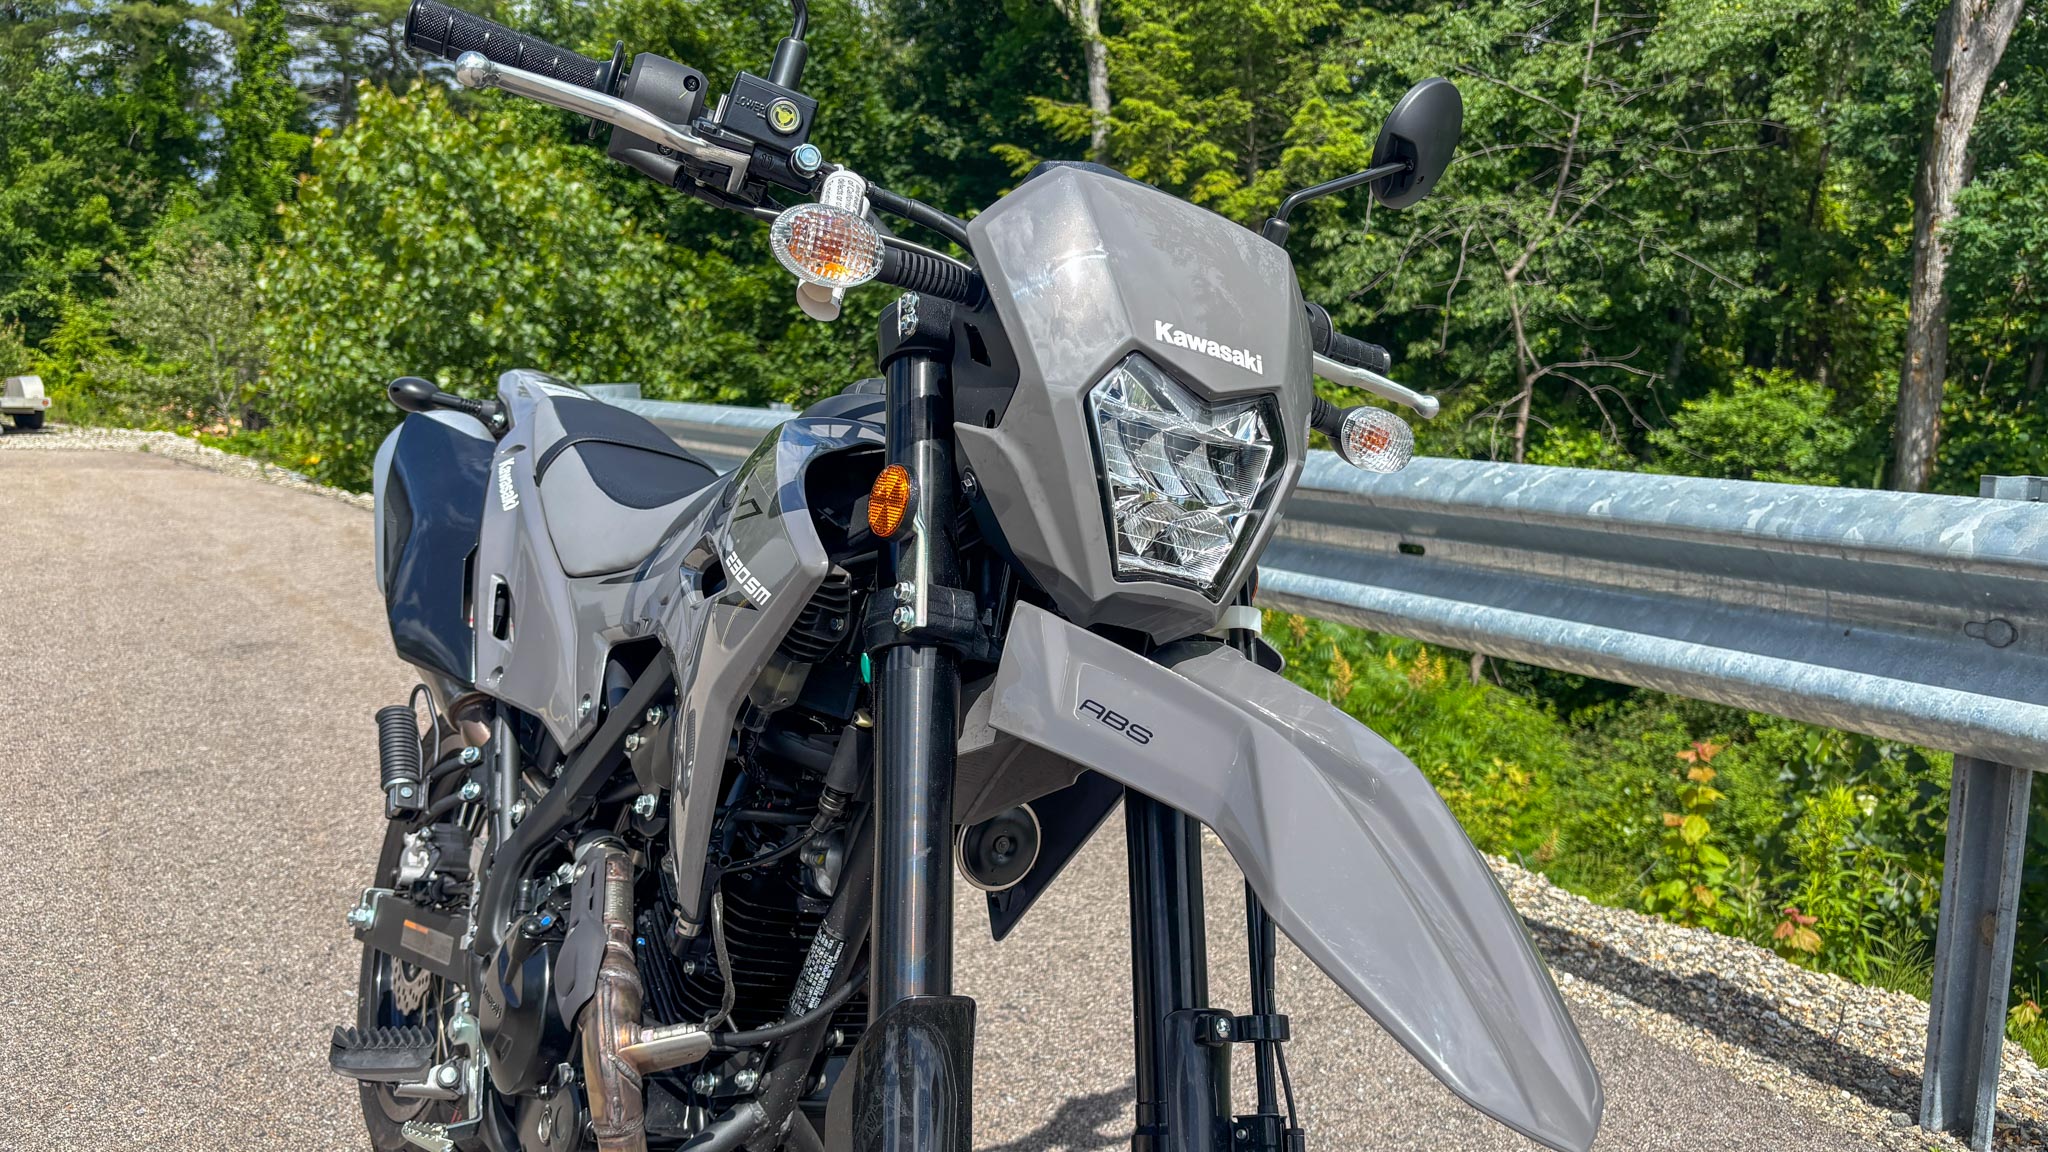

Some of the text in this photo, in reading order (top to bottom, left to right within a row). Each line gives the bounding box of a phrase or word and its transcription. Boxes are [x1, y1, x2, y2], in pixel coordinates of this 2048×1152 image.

[735, 95, 766, 112] LOWER
[1155, 319, 1263, 375] Kawasaki
[498, 457, 520, 511] Kawasaki
[1079, 699, 1153, 744] ABS
